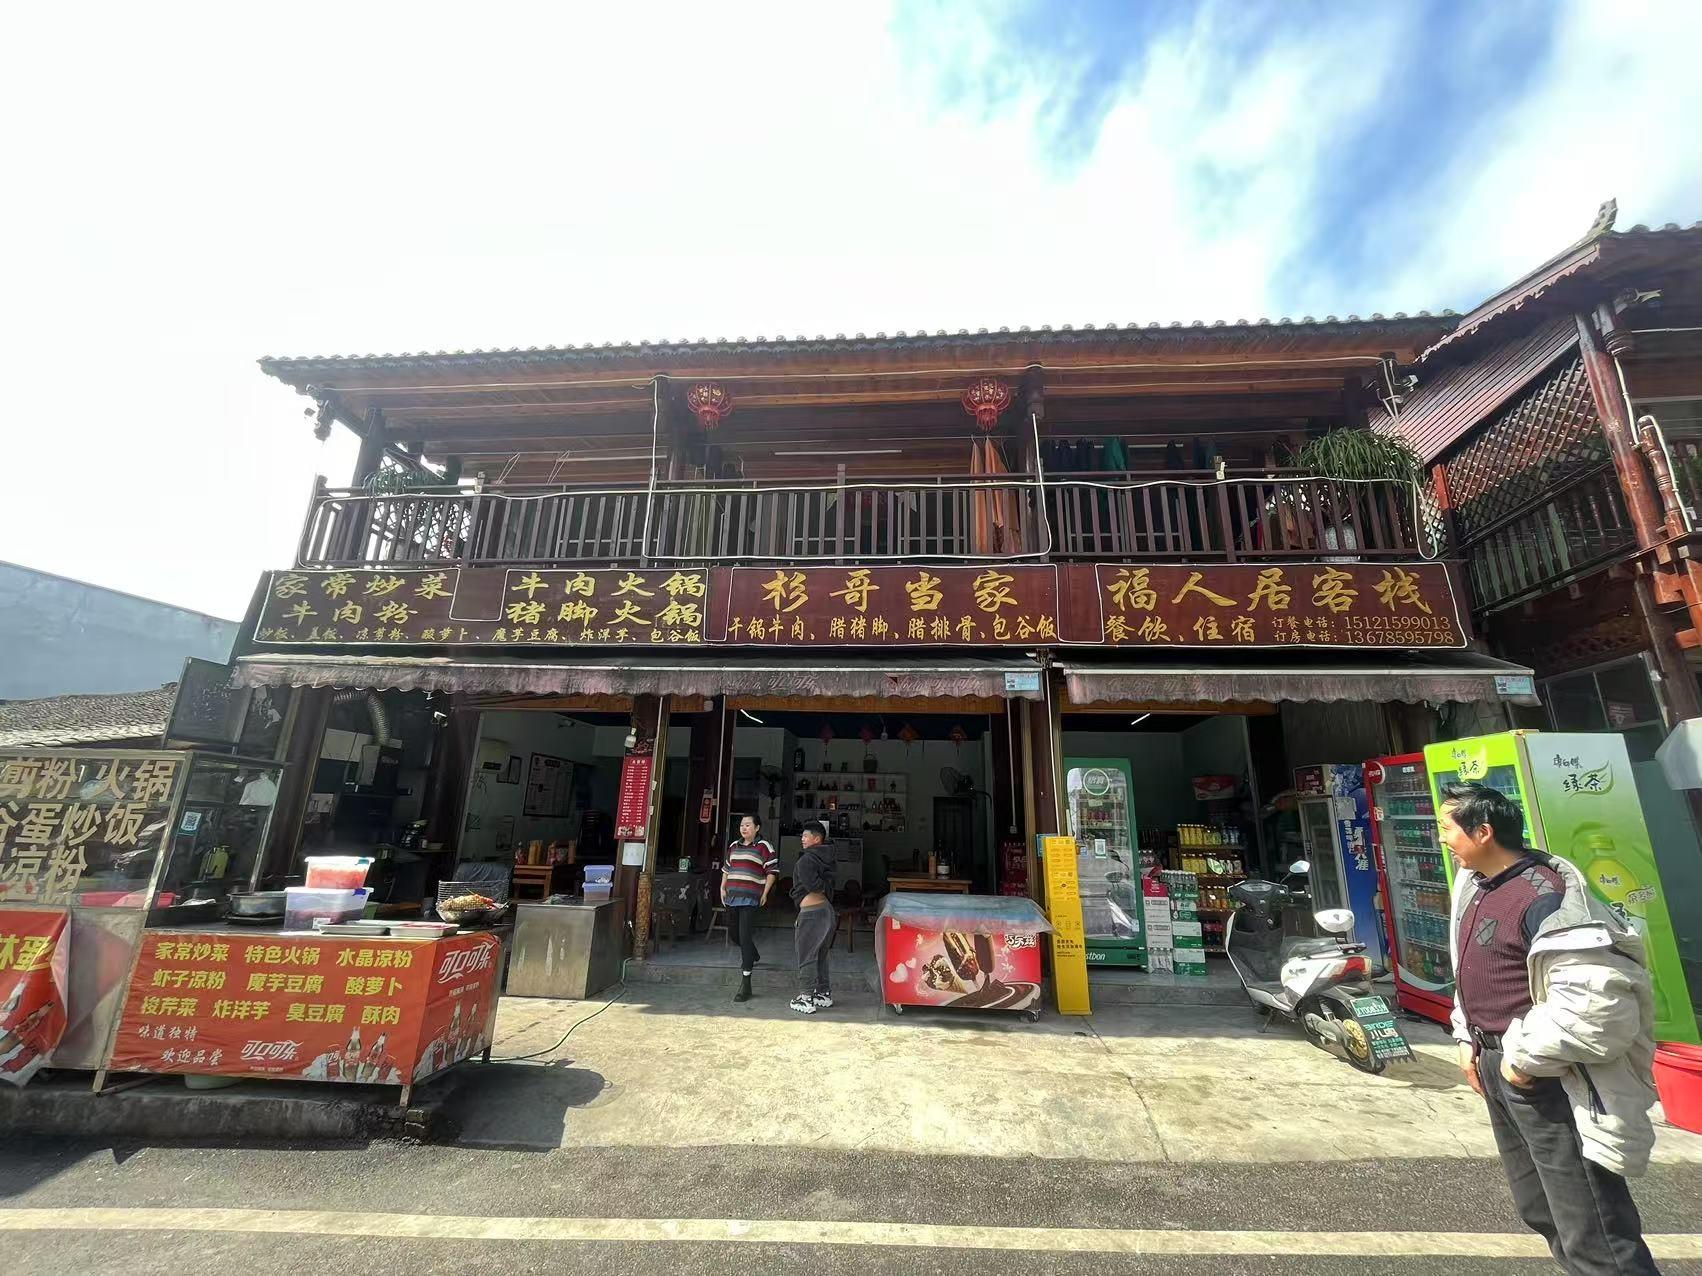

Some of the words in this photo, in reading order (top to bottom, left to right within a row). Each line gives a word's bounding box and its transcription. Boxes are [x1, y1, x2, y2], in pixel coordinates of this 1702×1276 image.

[275, 572, 453, 600] 家常炒菜
[511, 571, 706, 599] 牛肉火锅
[761, 569, 1018, 613] 杉哥当家
[1106, 566, 1432, 615] 福人居客栈
[282, 600, 418, 626] 牛肉粉
[505, 599, 703, 627] 猪脚火锅
[1563, 773, 1602, 792] 绿茶
[155, 942, 231, 961] 家常炒菜
[244, 945, 321, 966] 特色火锅
[336, 948, 414, 968] 水晶凉粉
[151, 969, 227, 990] 虾子凉粉
[246, 972, 324, 994] 魔芋豆腐
[344, 976, 403, 997] 酸萝卜
[211, 999, 272, 1020] 炸洋芋
[285, 1002, 346, 1023] 臭豆腐
[361, 1005, 401, 1025] 酥肉
[138, 1024, 198, 1041] 味道独特
[240, 1039, 304, 1061] 可口可乐
